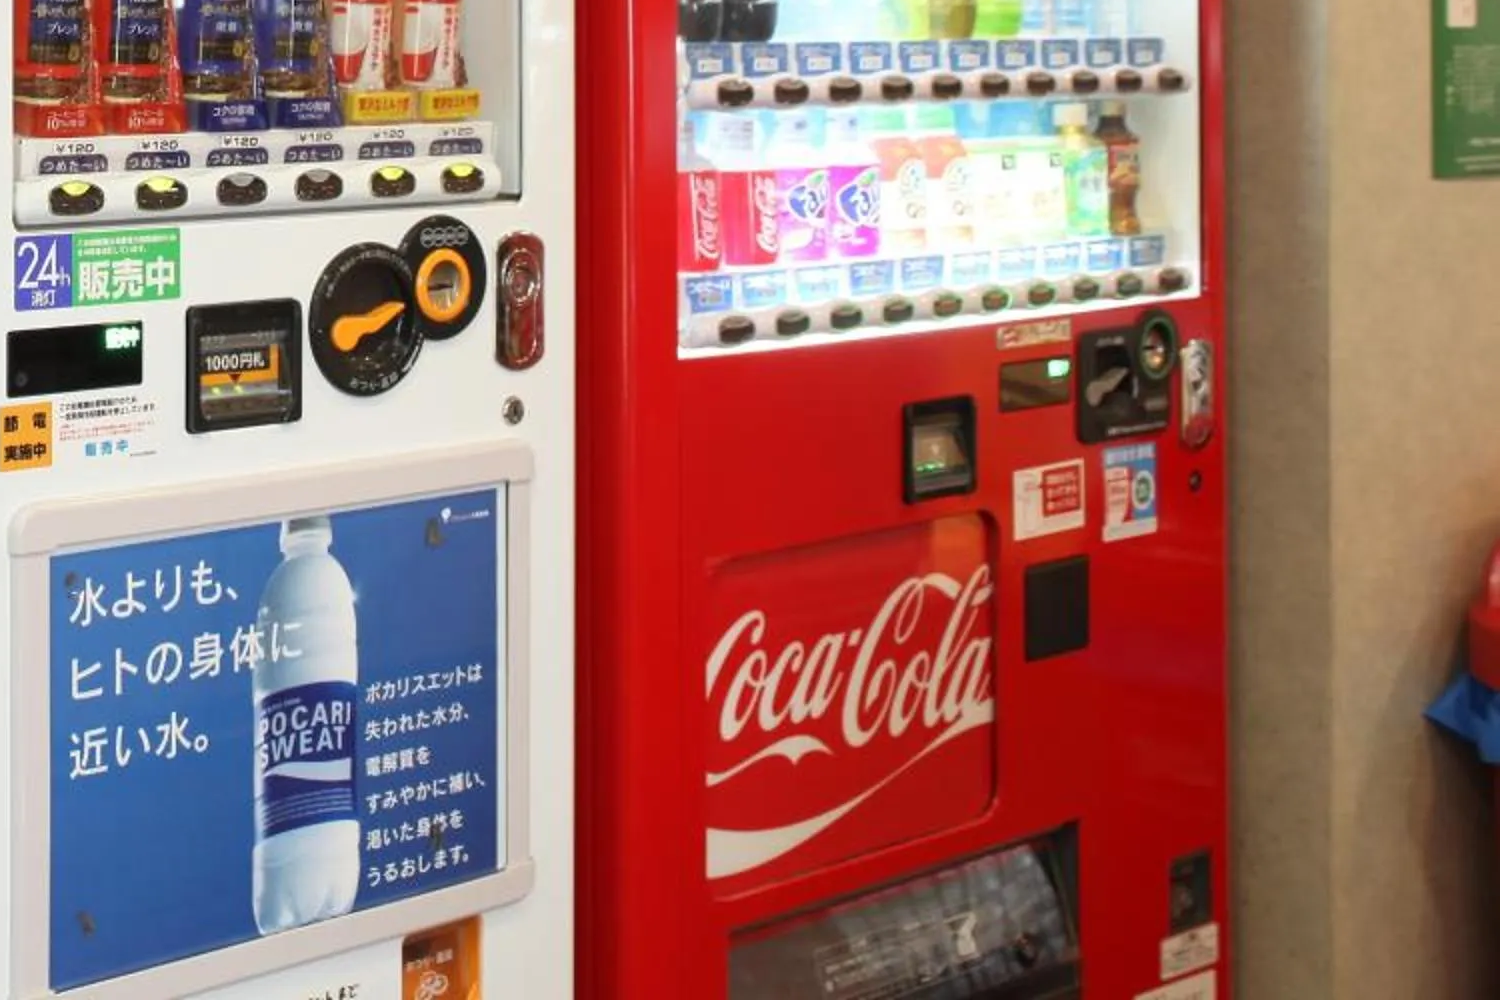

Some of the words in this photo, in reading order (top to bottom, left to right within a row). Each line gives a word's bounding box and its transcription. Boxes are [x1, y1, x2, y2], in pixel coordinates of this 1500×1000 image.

[18, 239, 71, 290] 24h
[77, 256, 177, 301] 販売中
[205, 352, 266, 373] 1000円札
[3, 442, 48, 463] 実施中
[70, 560, 239, 628] 水よりも、
[71, 623, 304, 702] ヒトの身体に
[706, 563, 994, 748] Coca-Cola
[366, 664, 483, 704] ポカリスエットは
[259, 700, 352, 743] POCARI
[365, 702, 470, 741] 失われた水分、
[70, 712, 210, 780] 近い水。
[259, 726, 347, 769] SWEAT
[366, 745, 432, 778] 電解質を
[366, 771, 487, 815] すみやかに補い、
[366, 810, 465, 852] 渇いた身体を
[367, 845, 470, 888] うるおします。
